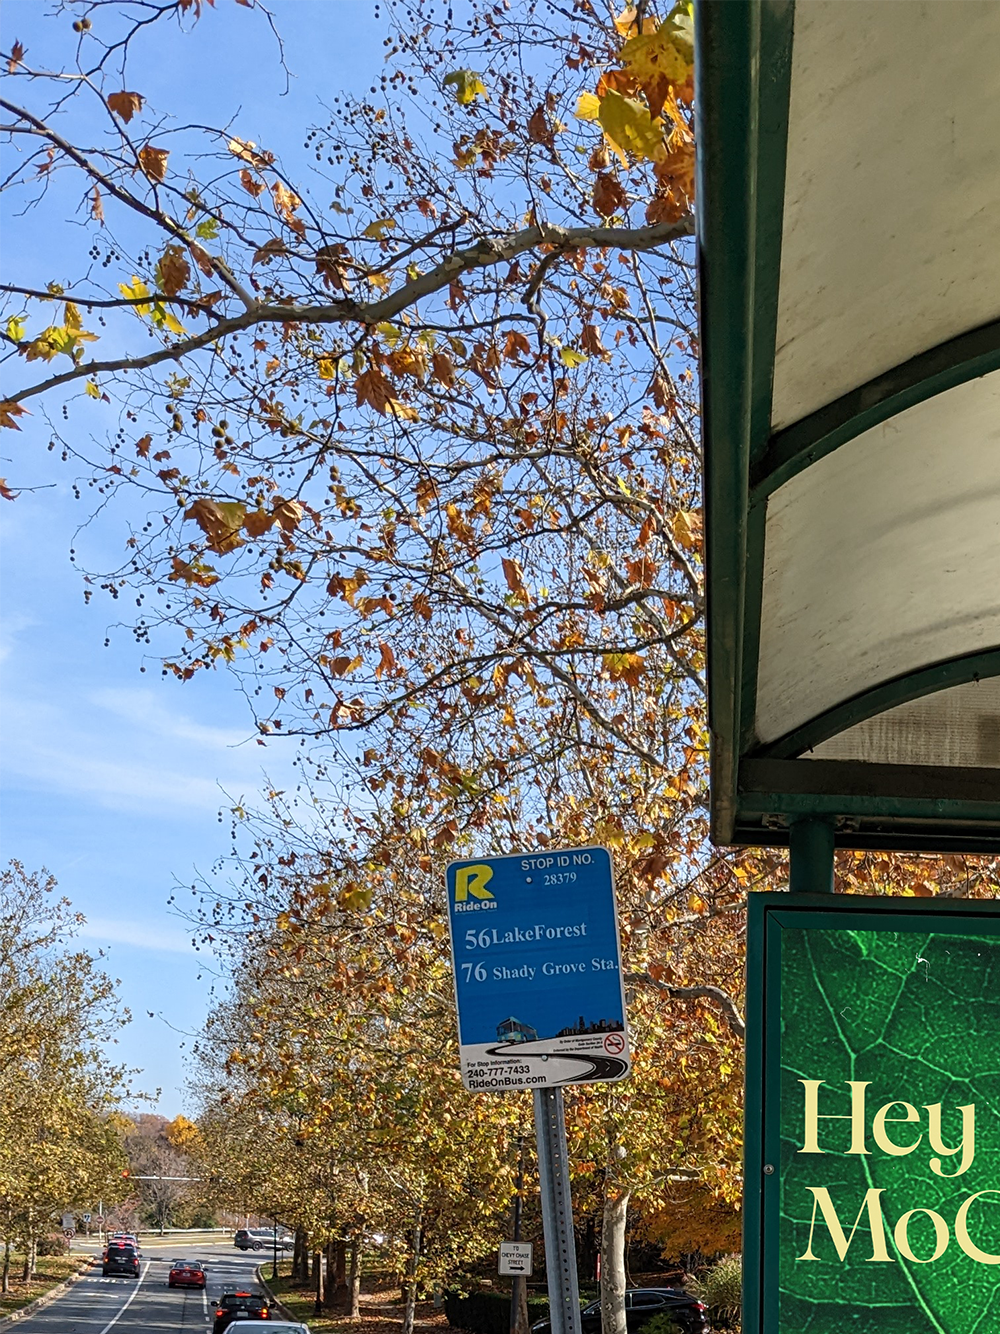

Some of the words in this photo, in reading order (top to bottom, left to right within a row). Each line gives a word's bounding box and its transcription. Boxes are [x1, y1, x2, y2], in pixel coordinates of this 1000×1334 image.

[521, 857, 554, 871] STOP
[557, 856, 570, 867] ID
[573, 853, 595, 866] NO.
[544, 872, 577, 886] 28379
[461, 961, 488, 983] 76
[493, 965, 537, 981] Shady
[542, 961, 587, 976] Grove
[591, 957, 619, 972] Sta.
[467, 1065, 531, 1079] 240-777-7433
[468, 1075, 547, 1089] RideOnBus.com
[797, 1079, 975, 1178] Hey
